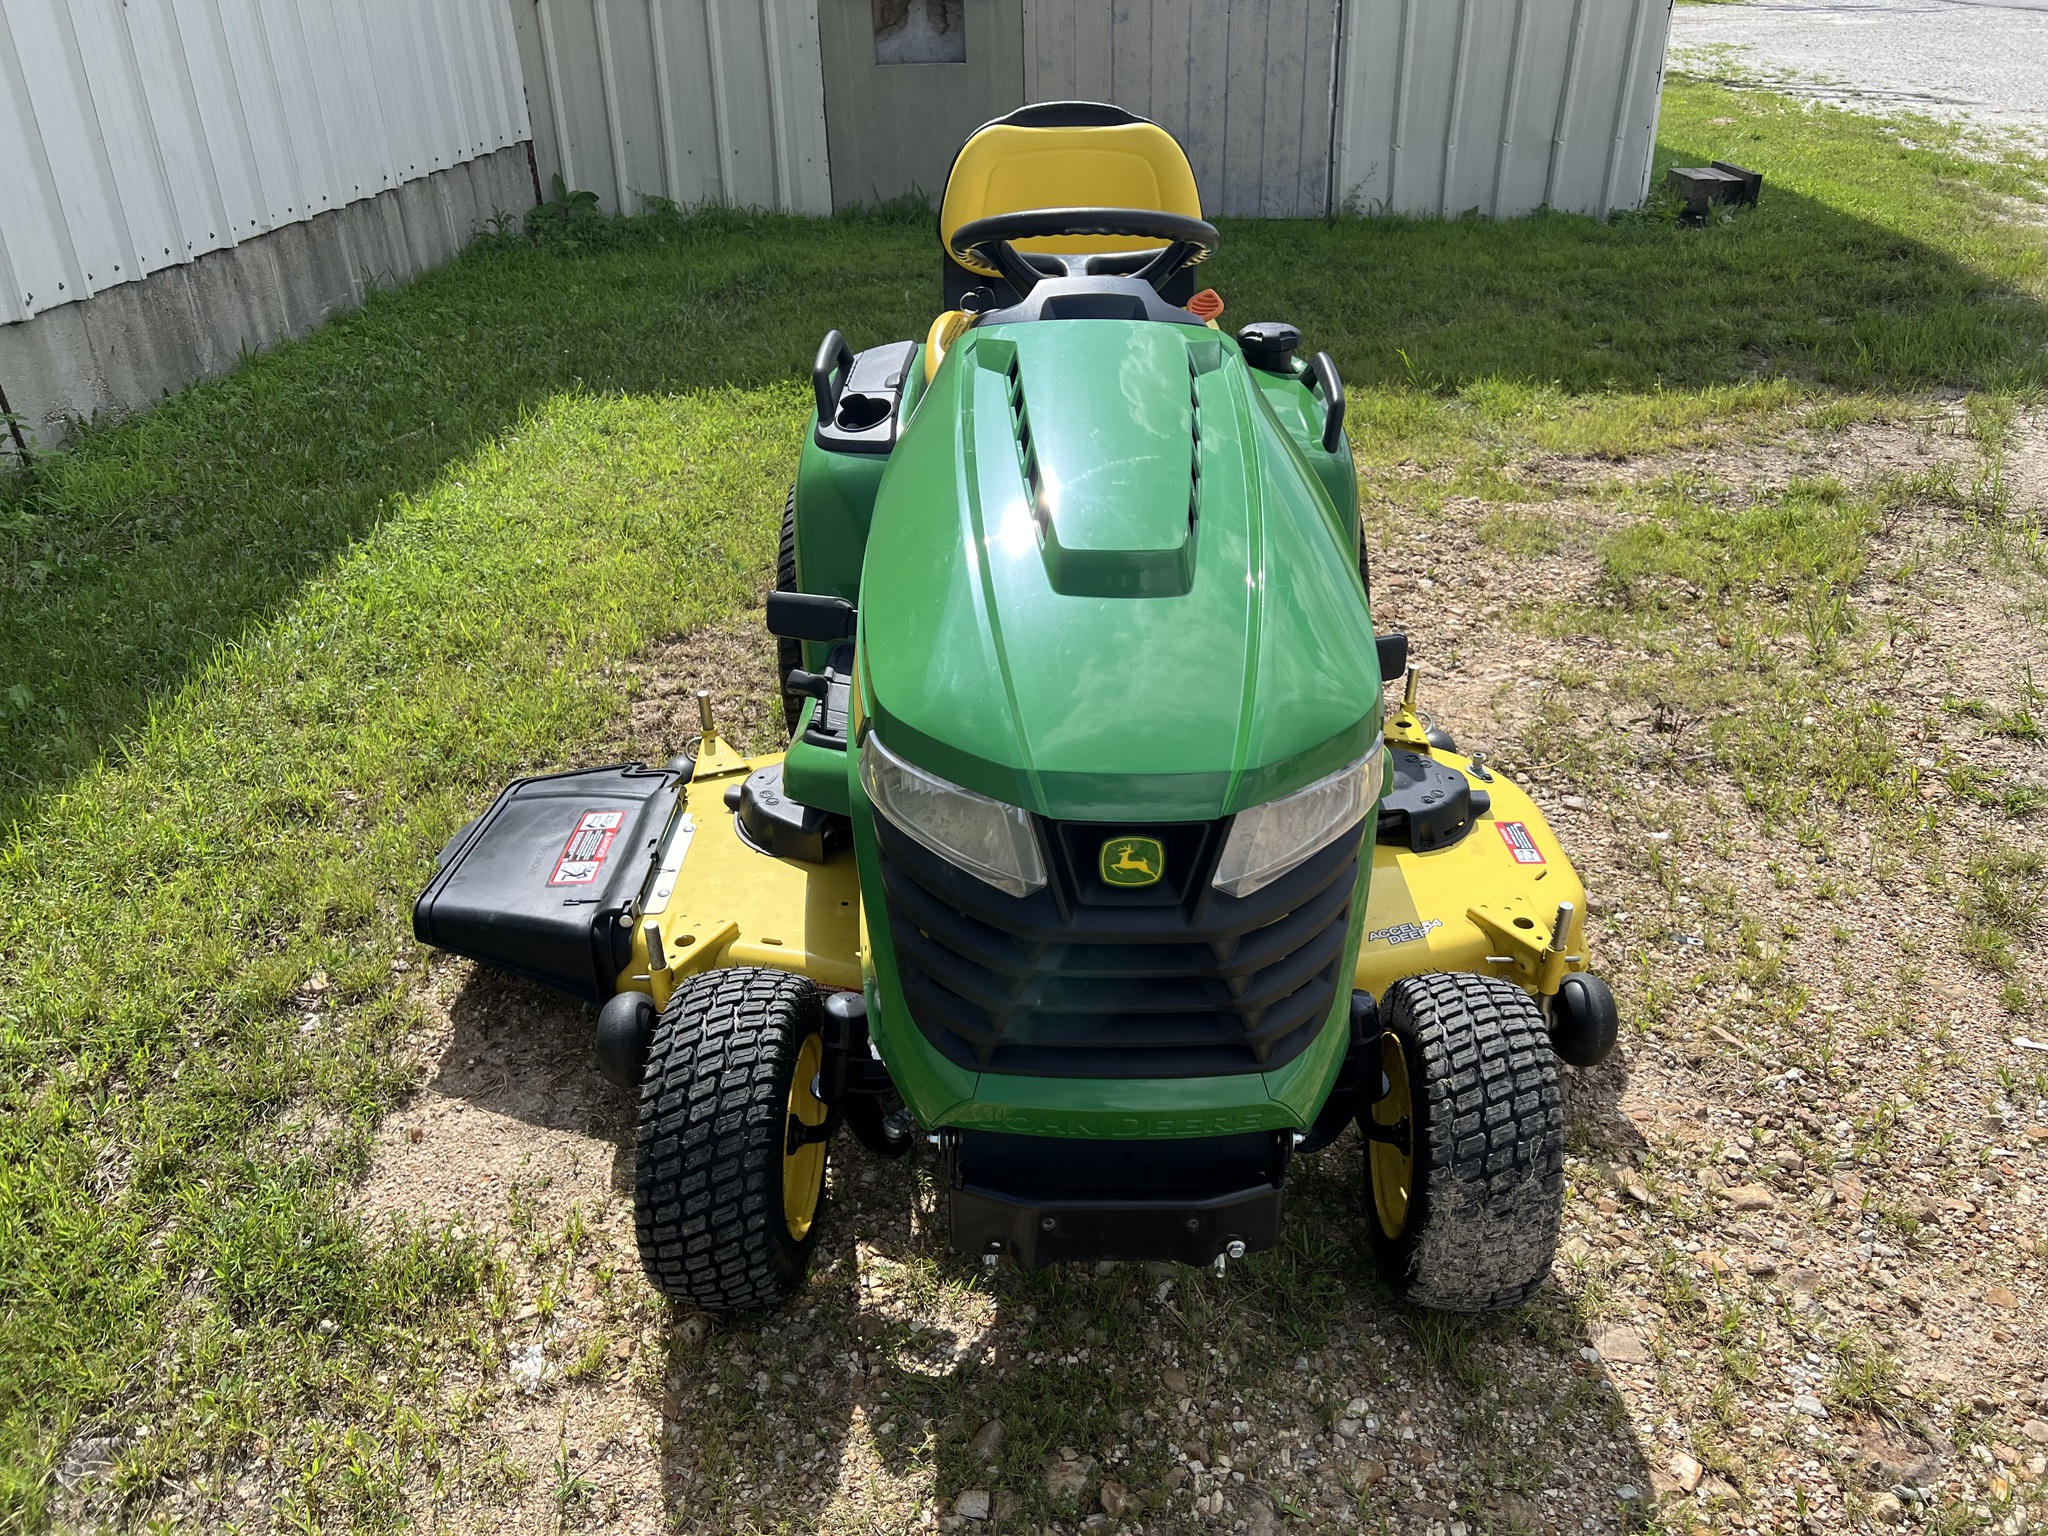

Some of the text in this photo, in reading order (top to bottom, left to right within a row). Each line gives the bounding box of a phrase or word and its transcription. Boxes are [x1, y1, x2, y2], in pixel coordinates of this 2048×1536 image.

[1369, 922, 1420, 941] ACCEL
[1388, 929, 1430, 945] DEEP
[818, 983, 846, 992] DANGER
[979, 1108, 1264, 1136] JOHN DEERE
